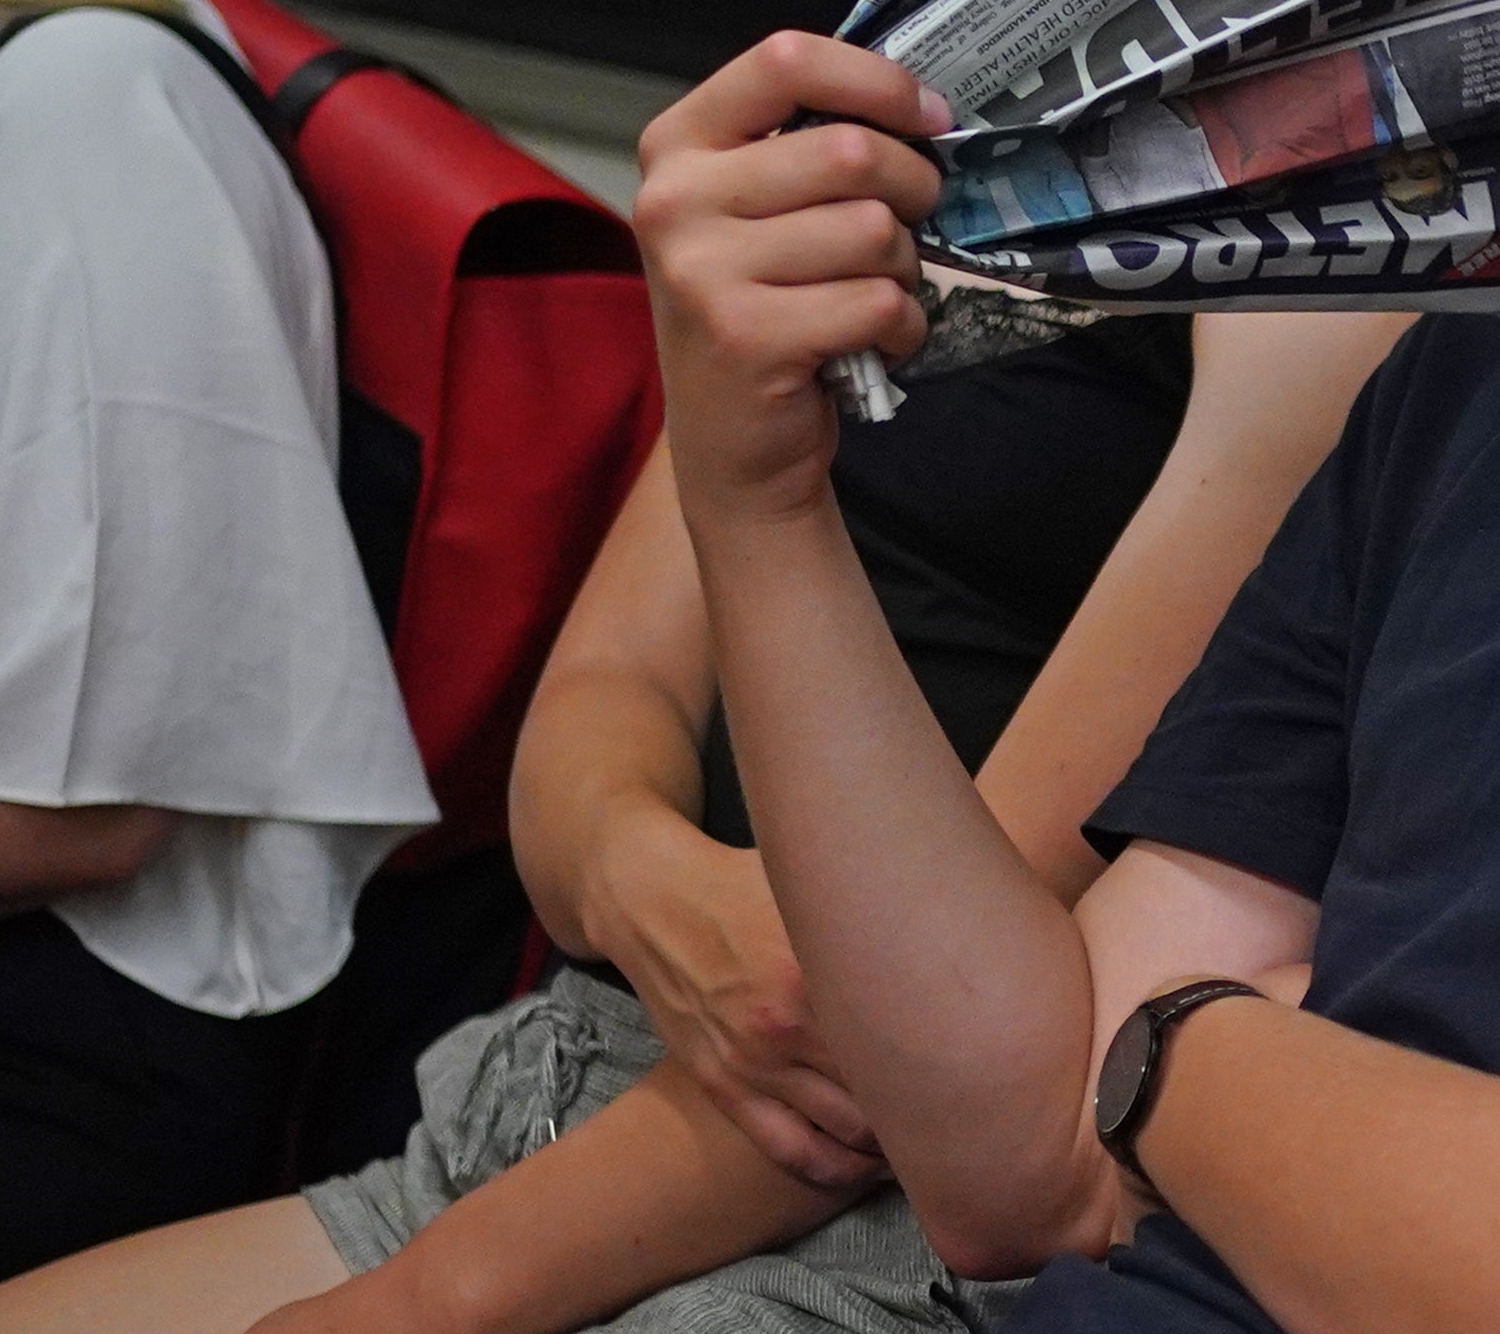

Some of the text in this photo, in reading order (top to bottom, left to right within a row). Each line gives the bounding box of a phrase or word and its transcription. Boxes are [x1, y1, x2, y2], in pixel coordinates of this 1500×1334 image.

[975, 13, 1027, 56] RADNEDGE
[999, 11, 1062, 64] HEALTH
[949, 57, 1002, 100] ALERT
[1078, 179, 1500, 291] METRO
